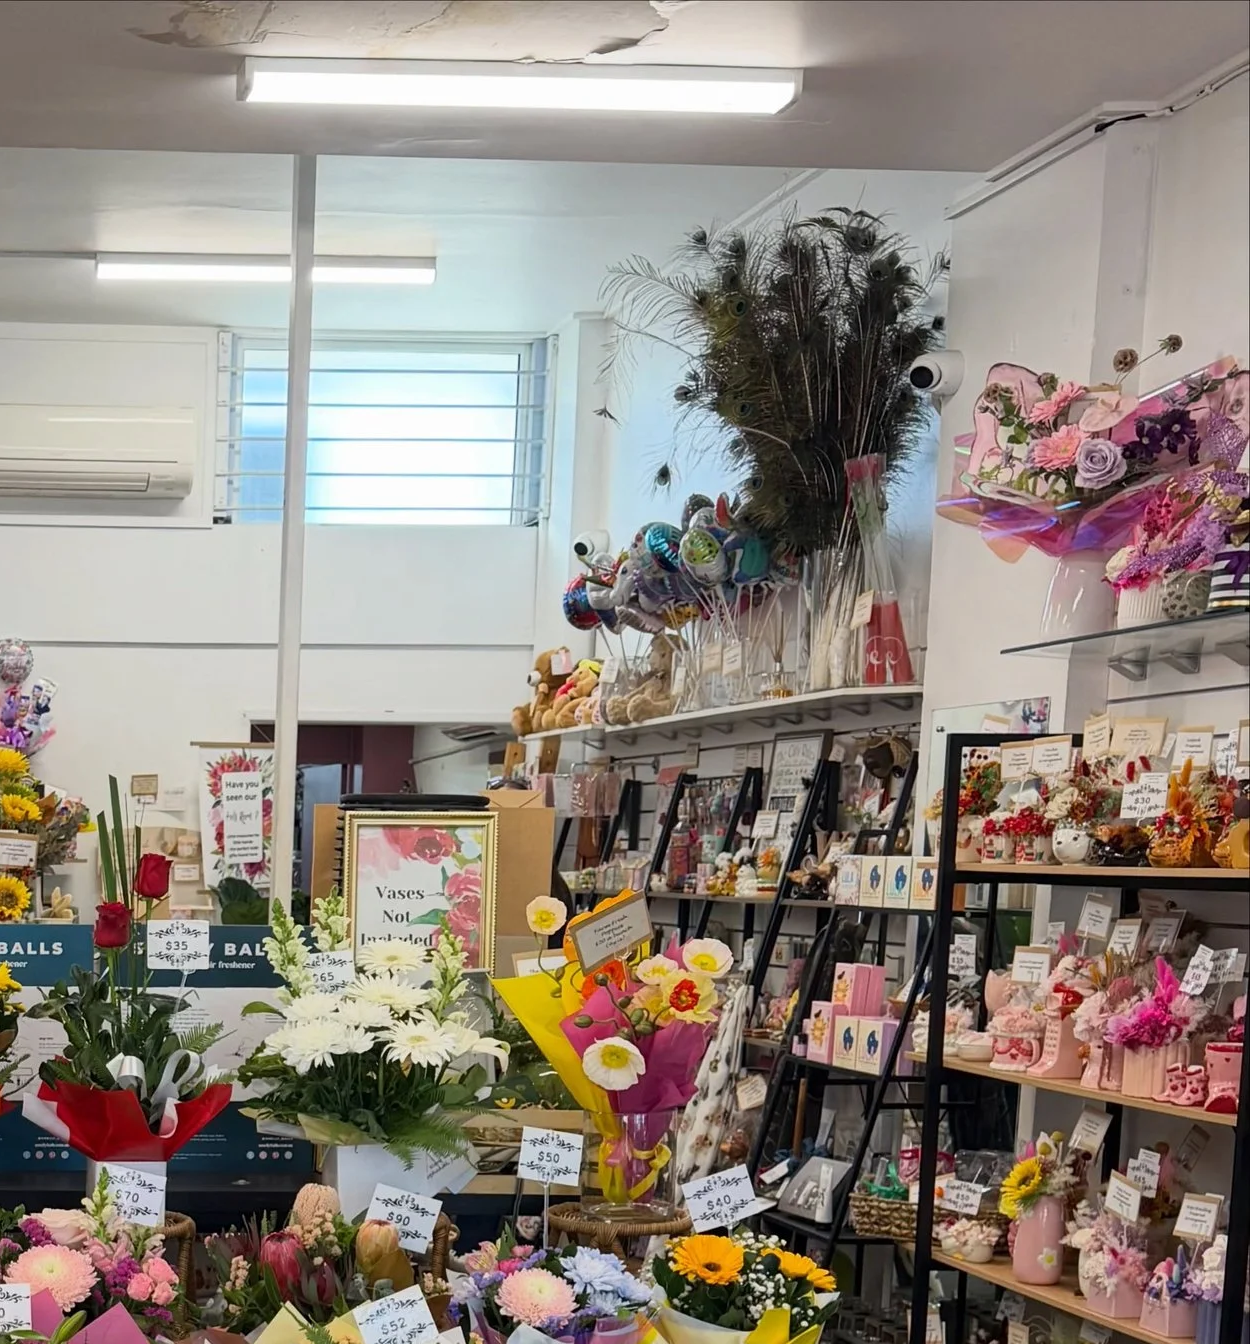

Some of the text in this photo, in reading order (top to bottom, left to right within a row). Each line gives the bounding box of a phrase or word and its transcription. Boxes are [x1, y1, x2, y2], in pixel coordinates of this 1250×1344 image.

[225, 780, 260, 790] Have you
[375, 885, 425, 900] Vases
[382, 909, 411, 924] Not
[165, 940, 189, 951] $35
[224, 941, 265, 956] BAL
[217, 961, 256, 970] freshener
[537, 1151, 561, 1164] $50
[115, 1188, 141, 1204] $70
[706, 1192, 733, 1210] $40
[386, 1212, 410, 1229] $90
[379, 1317, 407, 1335] $52
